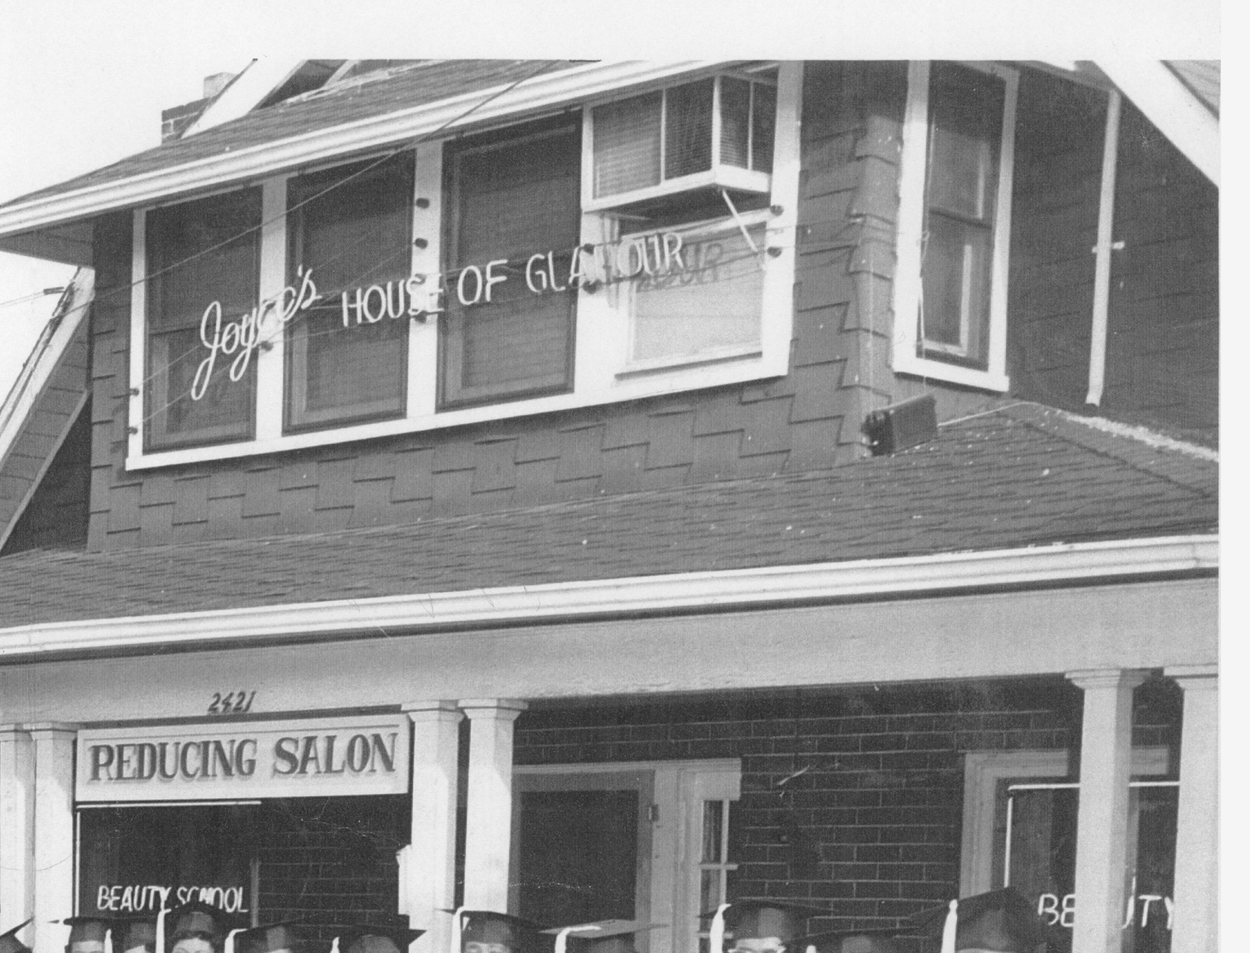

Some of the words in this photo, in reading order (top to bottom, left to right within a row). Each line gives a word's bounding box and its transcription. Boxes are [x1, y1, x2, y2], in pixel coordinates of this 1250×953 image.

[191, 265, 322, 401] Joyce's
[342, 274, 444, 327] HOUSE
[457, 259, 508, 305] OF
[207, 691, 257, 712] 2421
[88, 739, 258, 781] REDUCING
[275, 733, 398, 775] SALON
[97, 885, 171, 912] BEAUTY
[177, 886, 249, 912] SCHOOL
